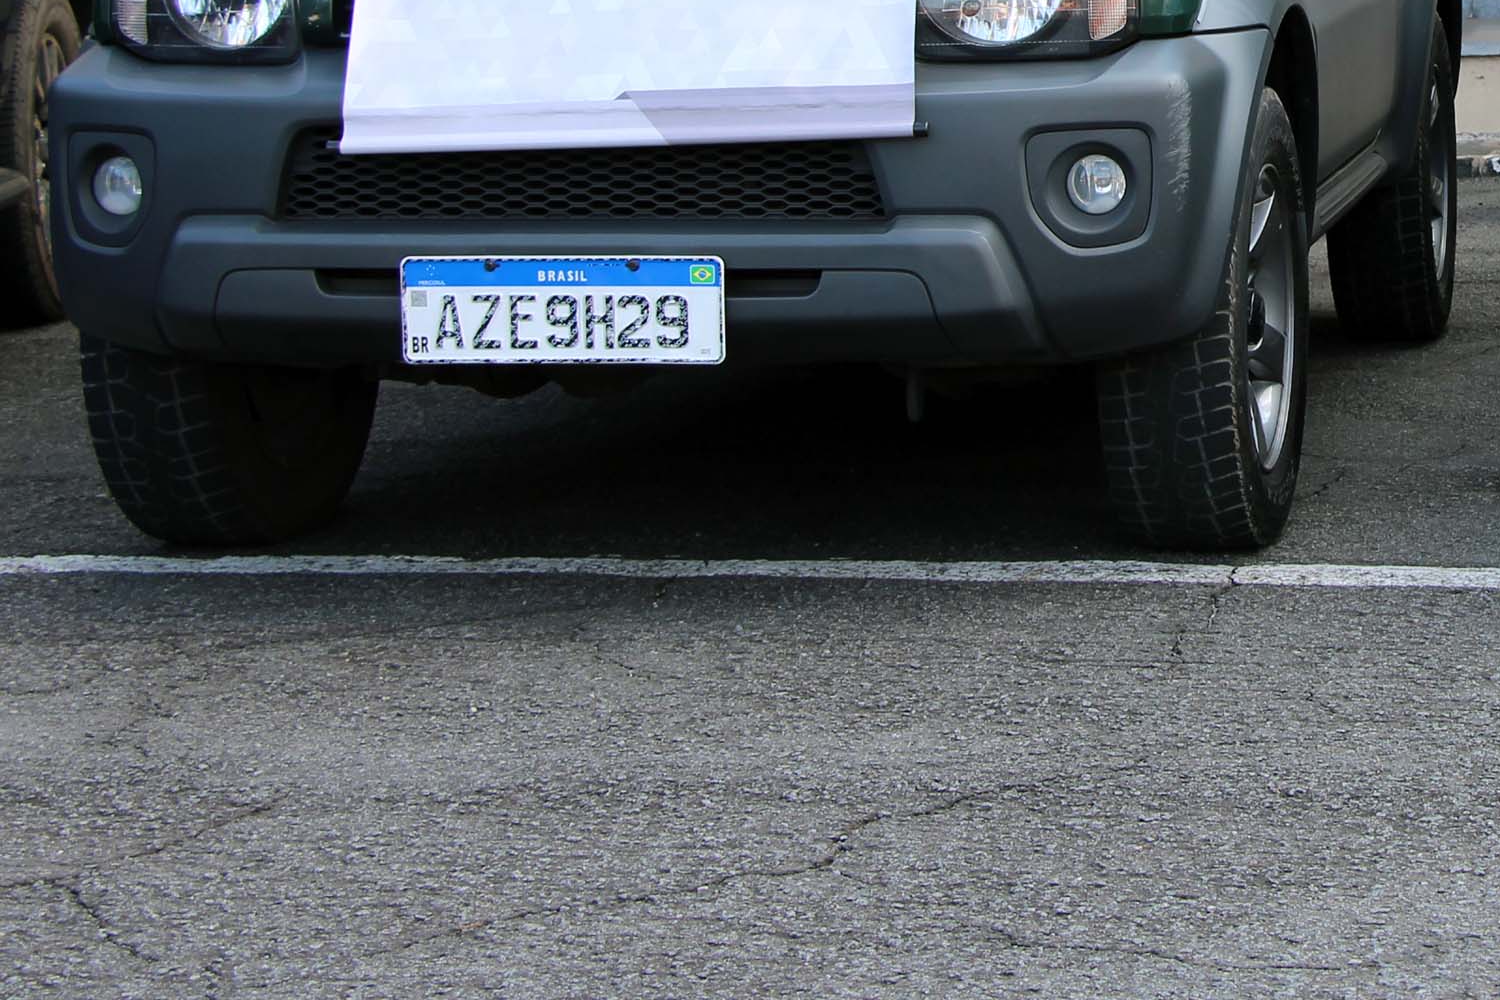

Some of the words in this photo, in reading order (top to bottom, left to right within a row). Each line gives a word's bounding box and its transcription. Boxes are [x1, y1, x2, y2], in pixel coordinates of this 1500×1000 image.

[537, 269, 588, 282] BRASIL
[435, 294, 690, 350] AZE9H29
[412, 336, 429, 353] BR
